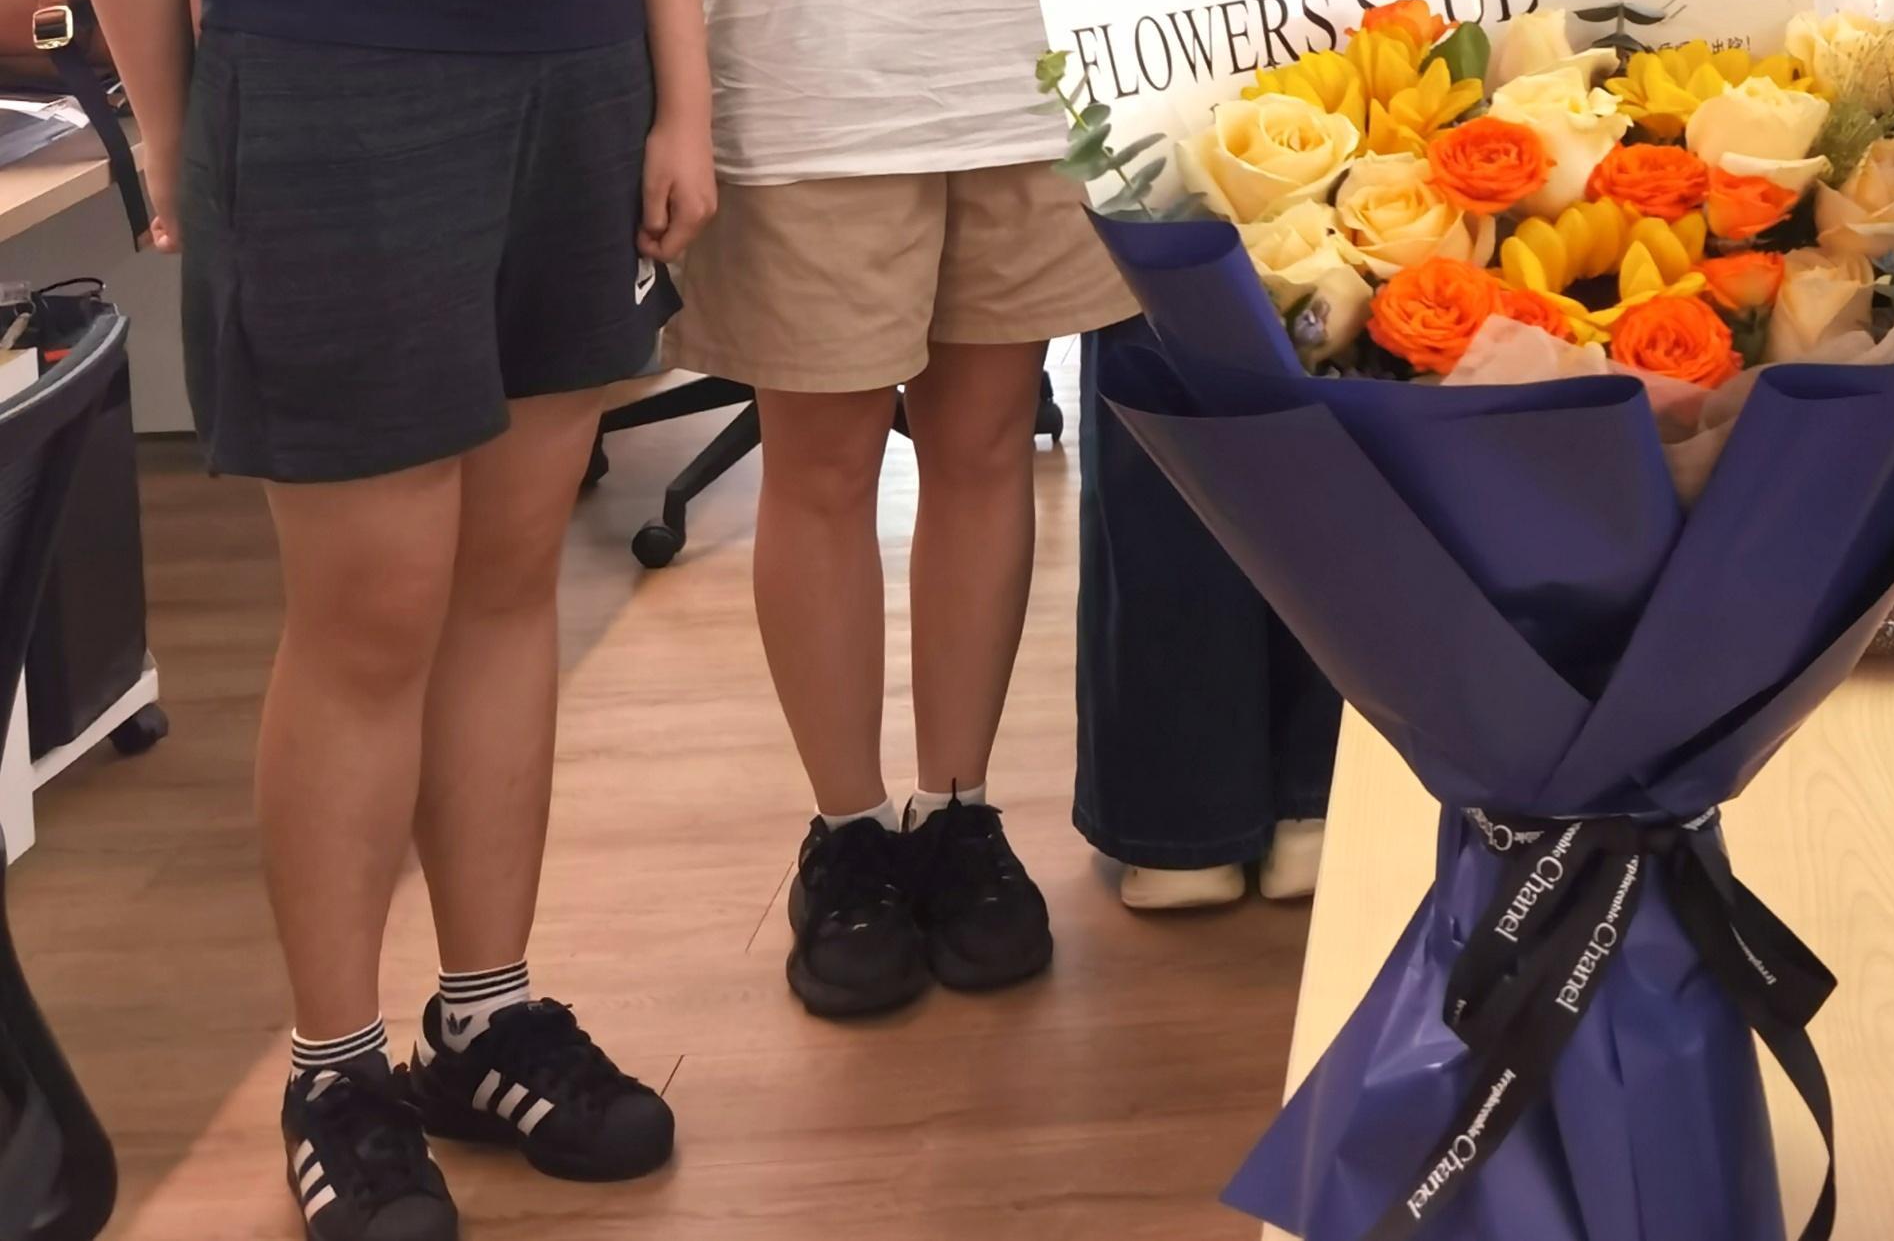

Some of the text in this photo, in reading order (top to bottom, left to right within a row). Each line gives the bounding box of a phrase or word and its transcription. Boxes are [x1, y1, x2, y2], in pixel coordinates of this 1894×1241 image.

[1494, 855, 1563, 942] Chanel
[1554, 922, 1617, 1014] Chanel
[1406, 1133, 1478, 1220] Chanel
